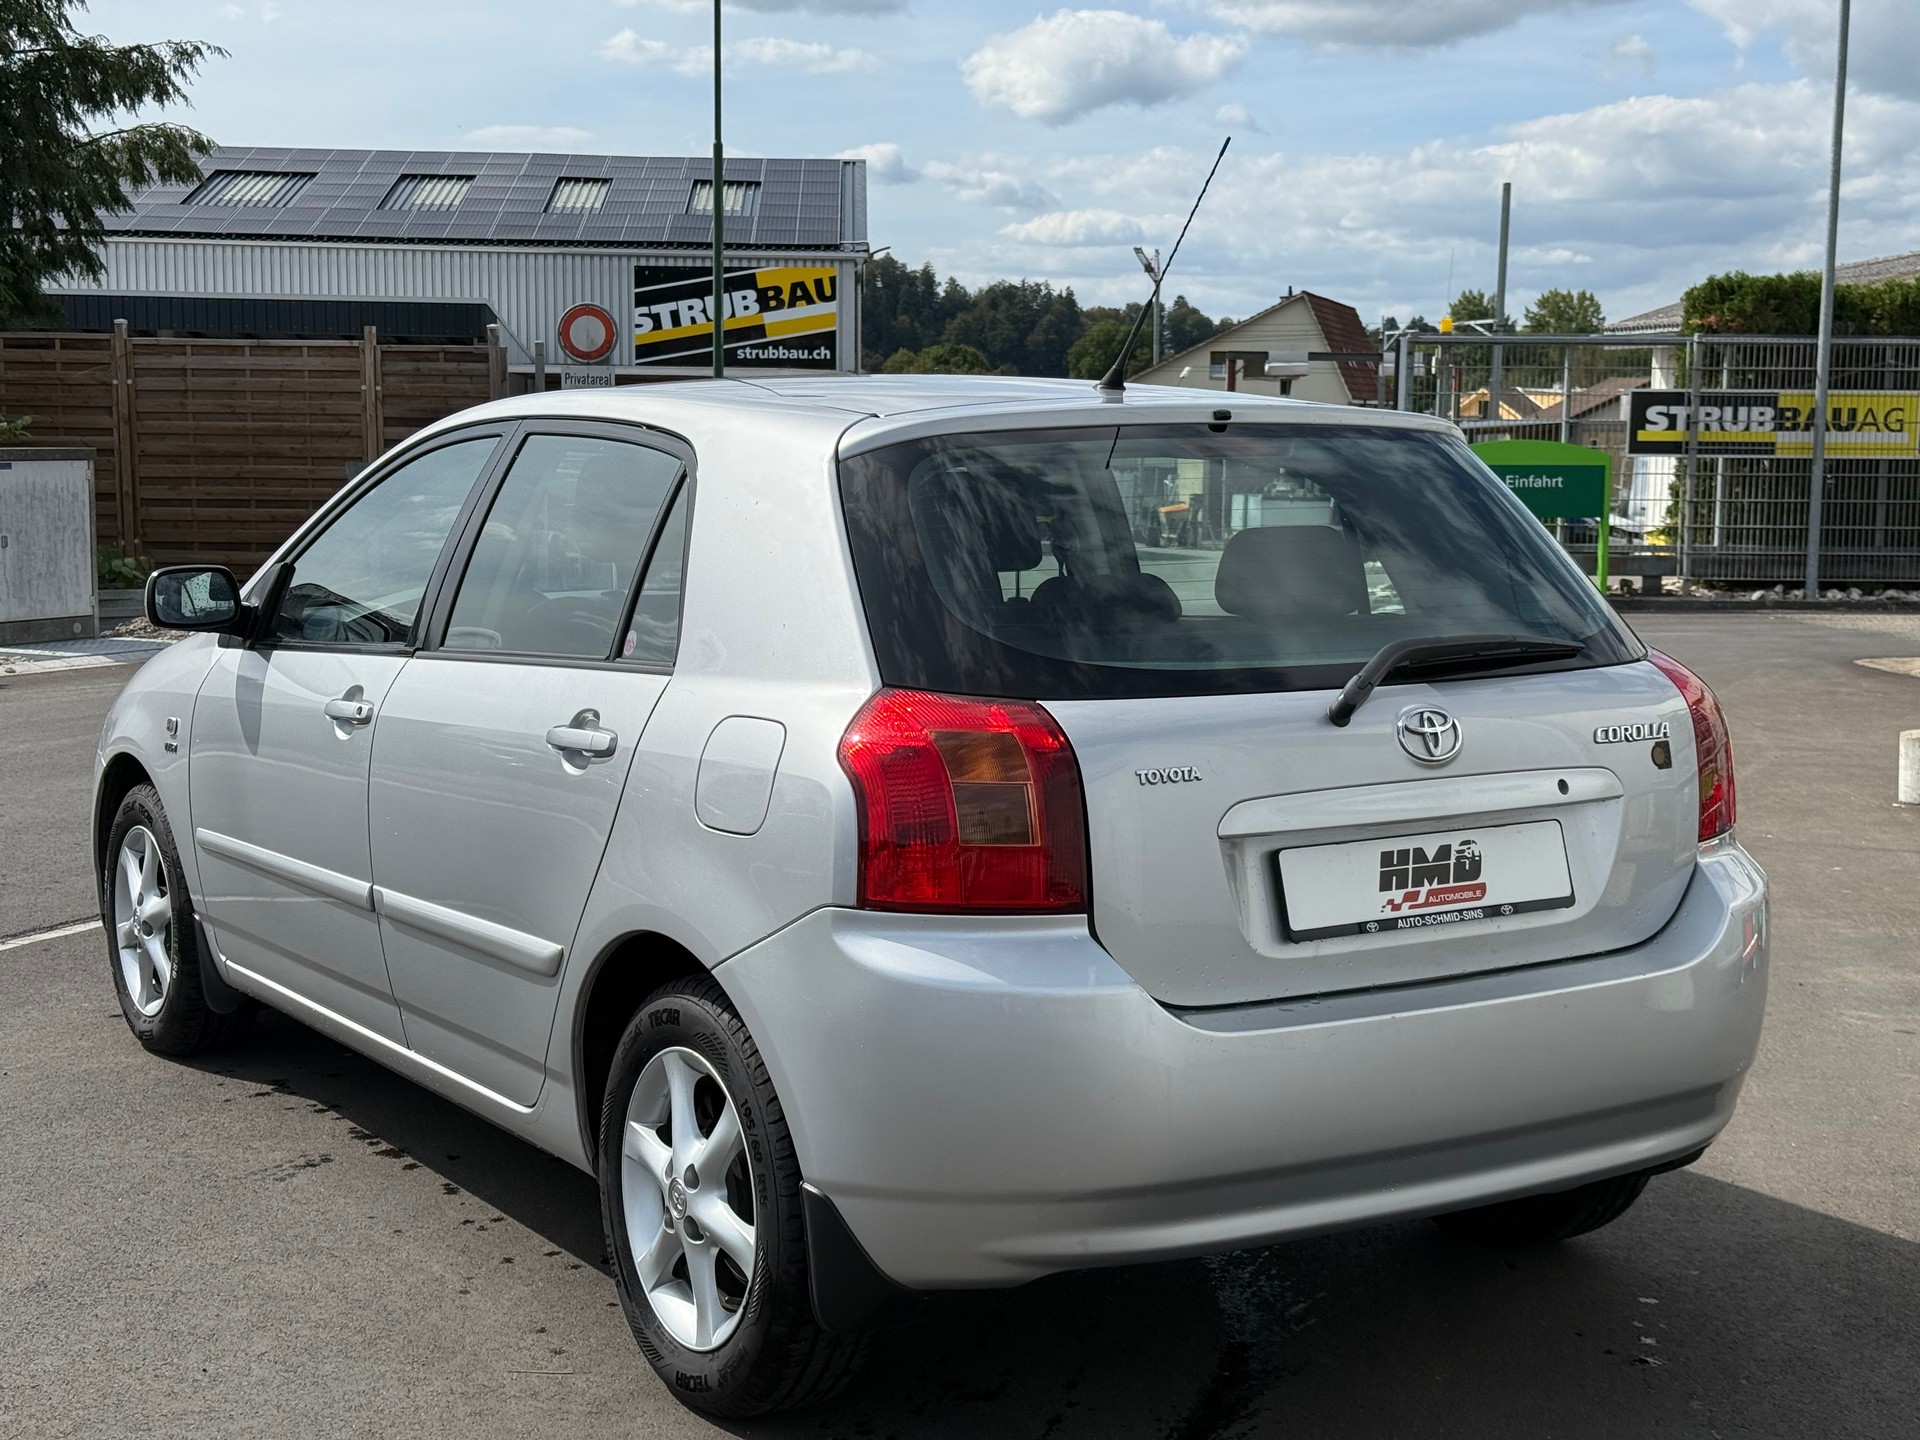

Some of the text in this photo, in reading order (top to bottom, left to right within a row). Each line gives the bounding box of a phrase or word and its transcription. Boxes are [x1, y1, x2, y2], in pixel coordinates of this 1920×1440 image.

[736, 346, 831, 361] strubbau.ch
[564, 372, 612, 386] Privatareal
[1505, 474, 1564, 488] Einfahrt
[1593, 721, 1670, 744] COROLLA
[1135, 766, 1203, 786] TOYOTA
[1428, 889, 1483, 904] AUTOMOBILE
[1397, 908, 1484, 929] AUTO-SCHMID-SINS
[647, 1008, 681, 1029] TECAR
